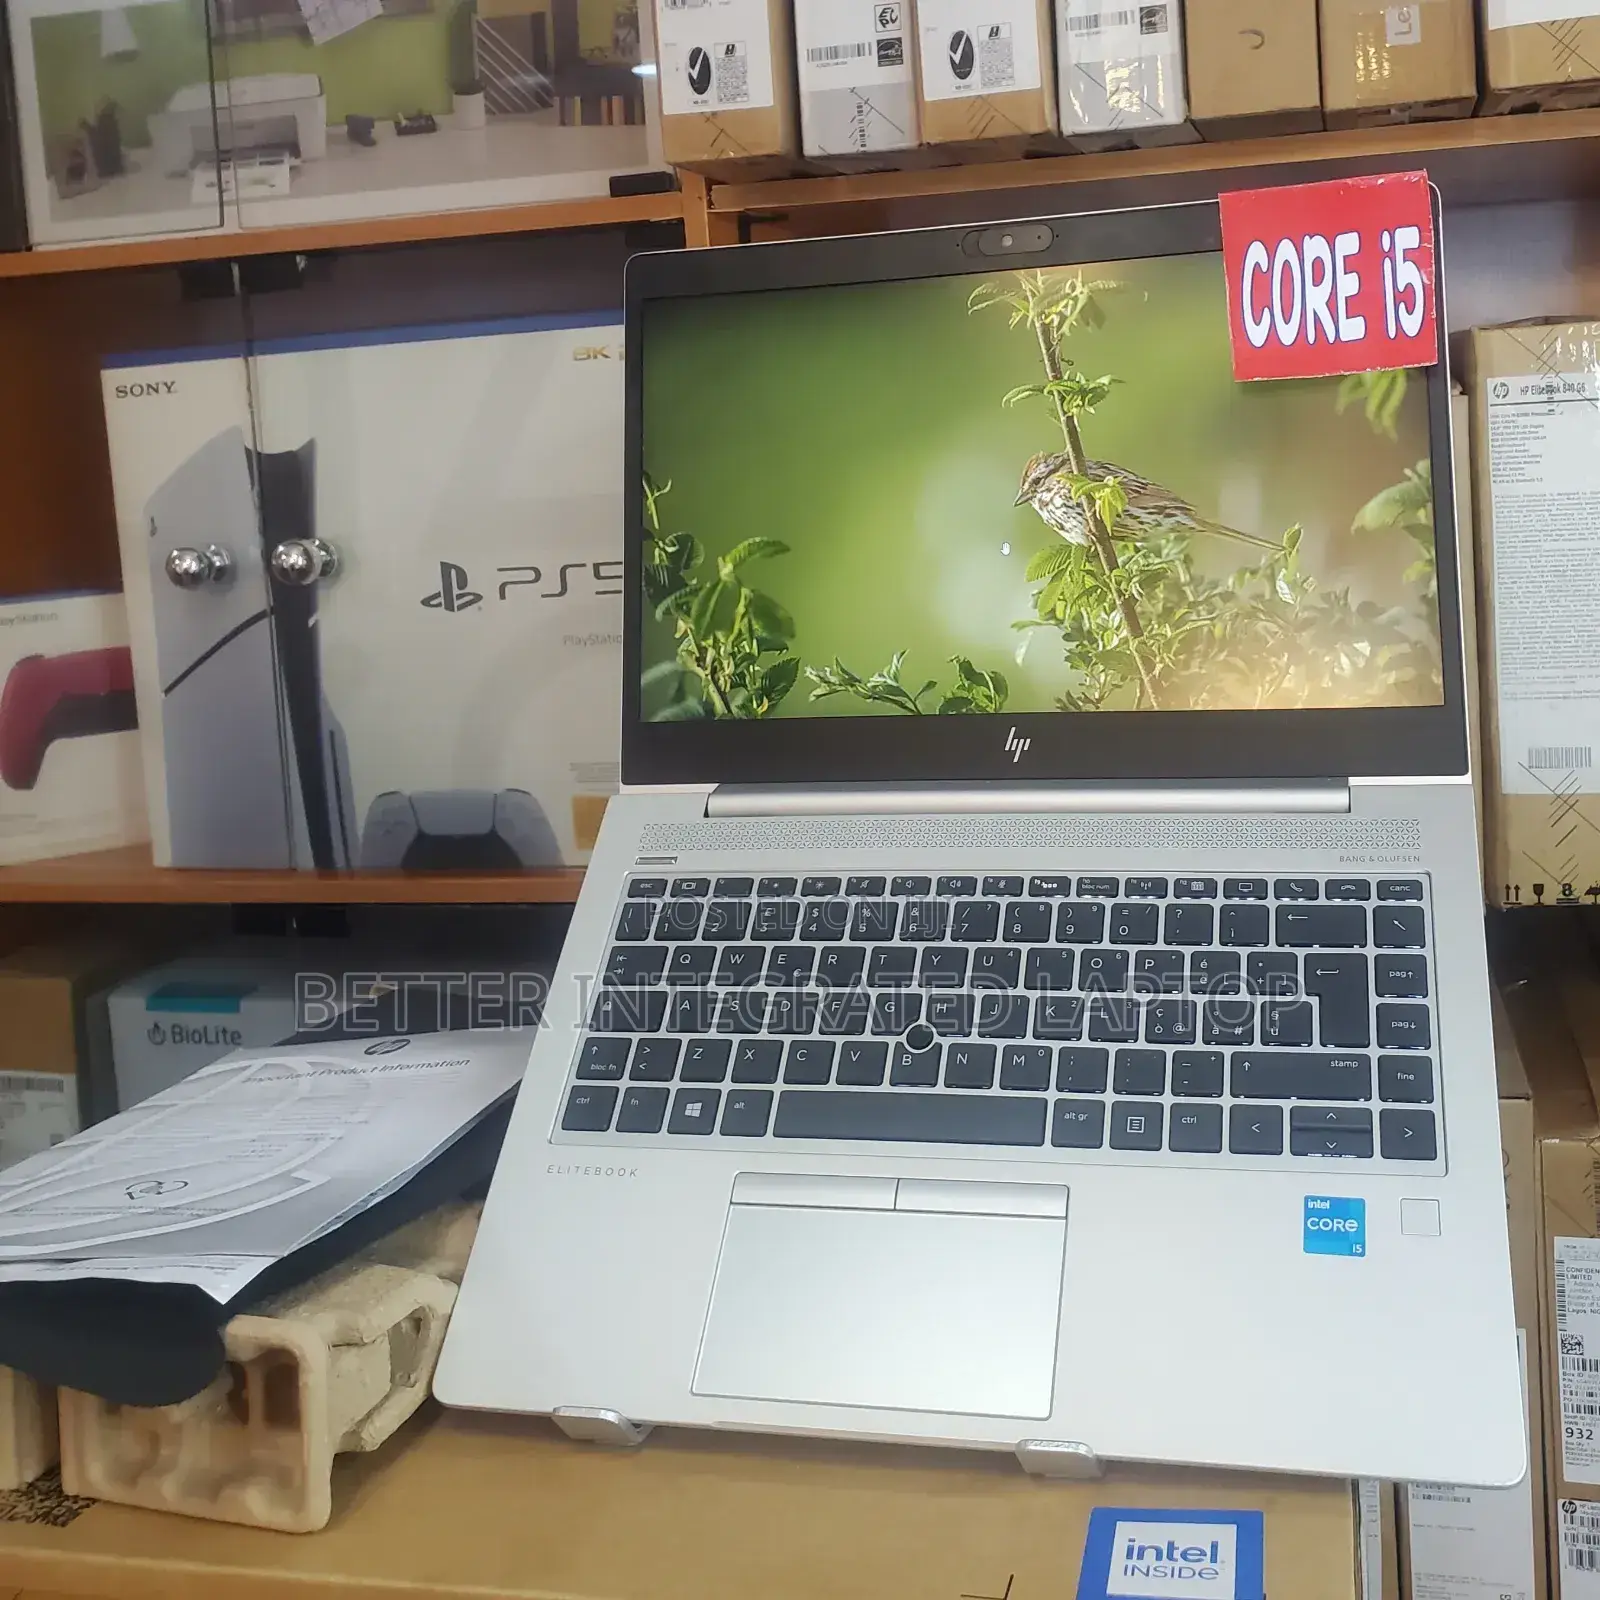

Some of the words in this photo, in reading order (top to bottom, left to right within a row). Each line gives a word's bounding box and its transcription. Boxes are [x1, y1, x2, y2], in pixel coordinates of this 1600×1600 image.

[1241, 231, 1366, 348] CORE
[1381, 225, 1426, 340] i5
[115, 380, 177, 399] SONY
[1520, 385, 1530, 396] HP
[497, 562, 623, 600] PS5
[562, 632, 623, 648] PlayStatio
[1340, 855, 1365, 863] BANG
[1369, 855, 1375, 863] &
[1377, 855, 1420, 863] OLUFSEN
[1389, 884, 1411, 892] canc
[811, 907, 820, 918] $
[861, 907, 871, 918] %
[911, 907, 919, 916] &
[1175, 909, 1183, 918] ?
[664, 923, 669, 932] 1
[711, 923, 719, 932] 2
[760, 923, 768, 932] 3
[809, 923, 817, 932] 4
[859, 923, 867, 933] 5
[909, 923, 918, 932] 6
[961, 923, 969, 933] 7
[1013, 923, 1022, 934] 8
[1066, 924, 1075, 935] 9
[679, 953, 691, 964] Q
[729, 953, 745, 964] W
[777, 953, 787, 964] E
[827, 954, 838, 965] R
[878, 954, 888, 965] T
[931, 955, 942, 966] Y
[983, 956, 994, 967] U
[1115, 952, 1122, 960] 6
[1090, 957, 1103, 969] O
[1144, 958, 1155, 970] P
[1389, 971, 1407, 979] pag
[680, 1000, 691, 1011] A
[730, 1000, 740, 1011] S
[780, 1000, 791, 1011] D
[831, 1001, 841, 1012] F
[884, 1001, 896, 1012] G
[936, 1003, 947, 1014] H
[990, 1004, 999, 1015] J
[1046, 1005, 1056, 1016] K
[1100, 1007, 1109, 1019] L
[1173, 1022, 1186, 1035] @
[1233, 1026, 1243, 1035] #
[1391, 1021, 1409, 1030] pag
[171, 1023, 243, 1046] BioLite
[692, 1048, 703, 1059] Z
[743, 1048, 755, 1060] X
[796, 1049, 807, 1061] C
[850, 1051, 861, 1062] V
[956, 1053, 968, 1065] N
[379, 1059, 471, 1072] Information
[902, 1054, 912, 1066] B
[1013, 1055, 1025, 1066] M
[1330, 1059, 1359, 1069] stamp
[590, 1063, 607, 1071] bloc
[608, 1064, 617, 1072] fn
[1396, 1072, 1415, 1081] fine
[631, 1098, 639, 1106] fn
[1064, 1111, 1076, 1119] alt
[1078, 1113, 1088, 1121] gr
[1181, 1116, 1197, 1124] ctrl
[547, 1165, 638, 1178] ELITEBOOK
[1308, 1199, 1330, 1210] intel
[1565, 1427, 1594, 1440] 932
[1125, 1538, 1219, 1564] intel
